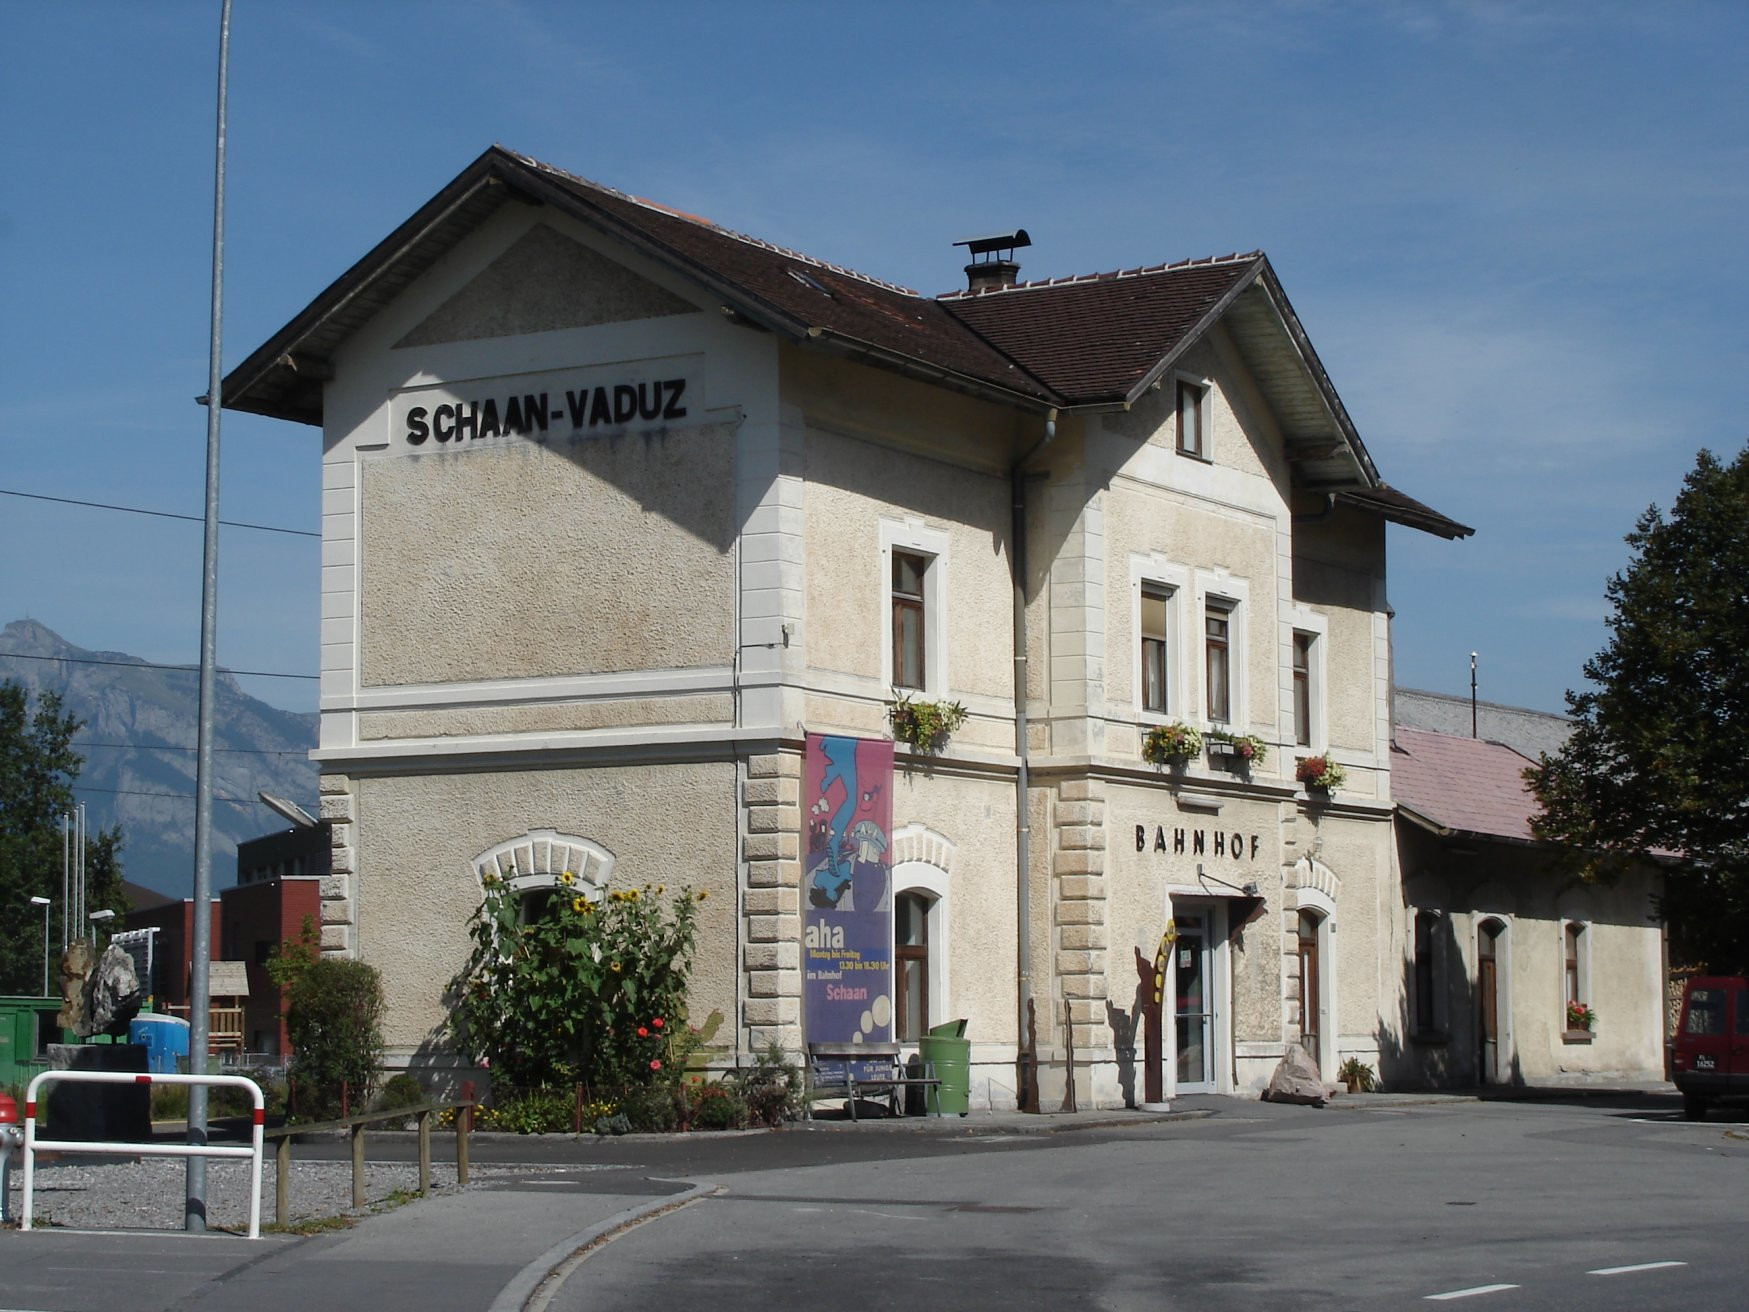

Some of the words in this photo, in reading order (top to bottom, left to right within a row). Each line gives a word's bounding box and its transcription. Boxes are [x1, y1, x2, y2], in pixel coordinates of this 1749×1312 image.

[406, 379, 687, 446] SCHAAN-VADUZ
[1135, 825, 1259, 861] BAHNHOF
[805, 918, 844, 948] aha
[810, 949, 831, 960] Montag
[831, 949, 840, 958] bis
[841, 949, 860, 960] Freitag
[855, 961, 863, 970] bis
[807, 970, 816, 979] im
[818, 970, 842, 979] Bahnhof
[826, 983, 867, 1000] Schaan
